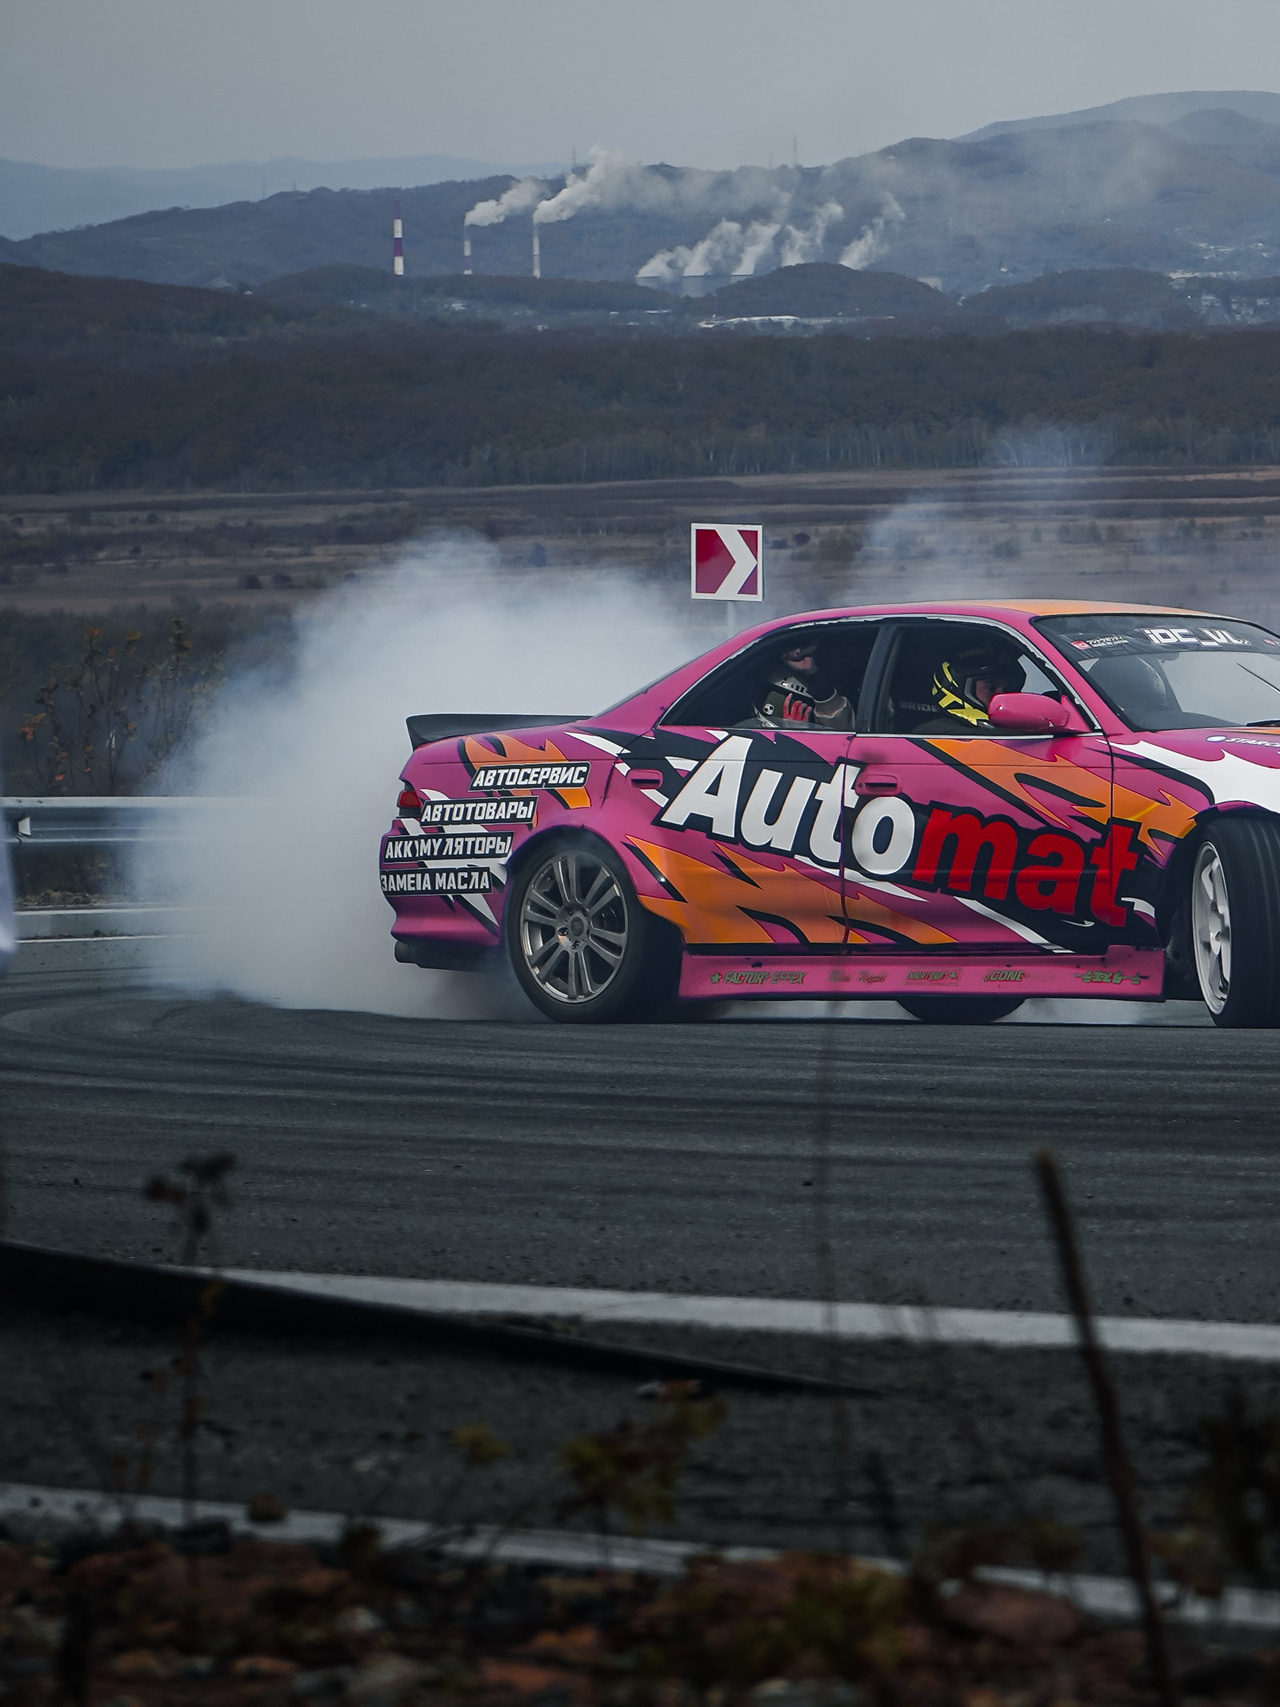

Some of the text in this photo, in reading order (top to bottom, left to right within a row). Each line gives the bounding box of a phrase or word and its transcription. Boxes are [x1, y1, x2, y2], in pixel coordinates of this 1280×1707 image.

[473, 767, 587, 787] АВТОСЕРВИС
[421, 801, 534, 822] АВТОТОВАРЫ
[661, 735, 1139, 927] Automat
[435, 871, 489, 891] МАСЛА
